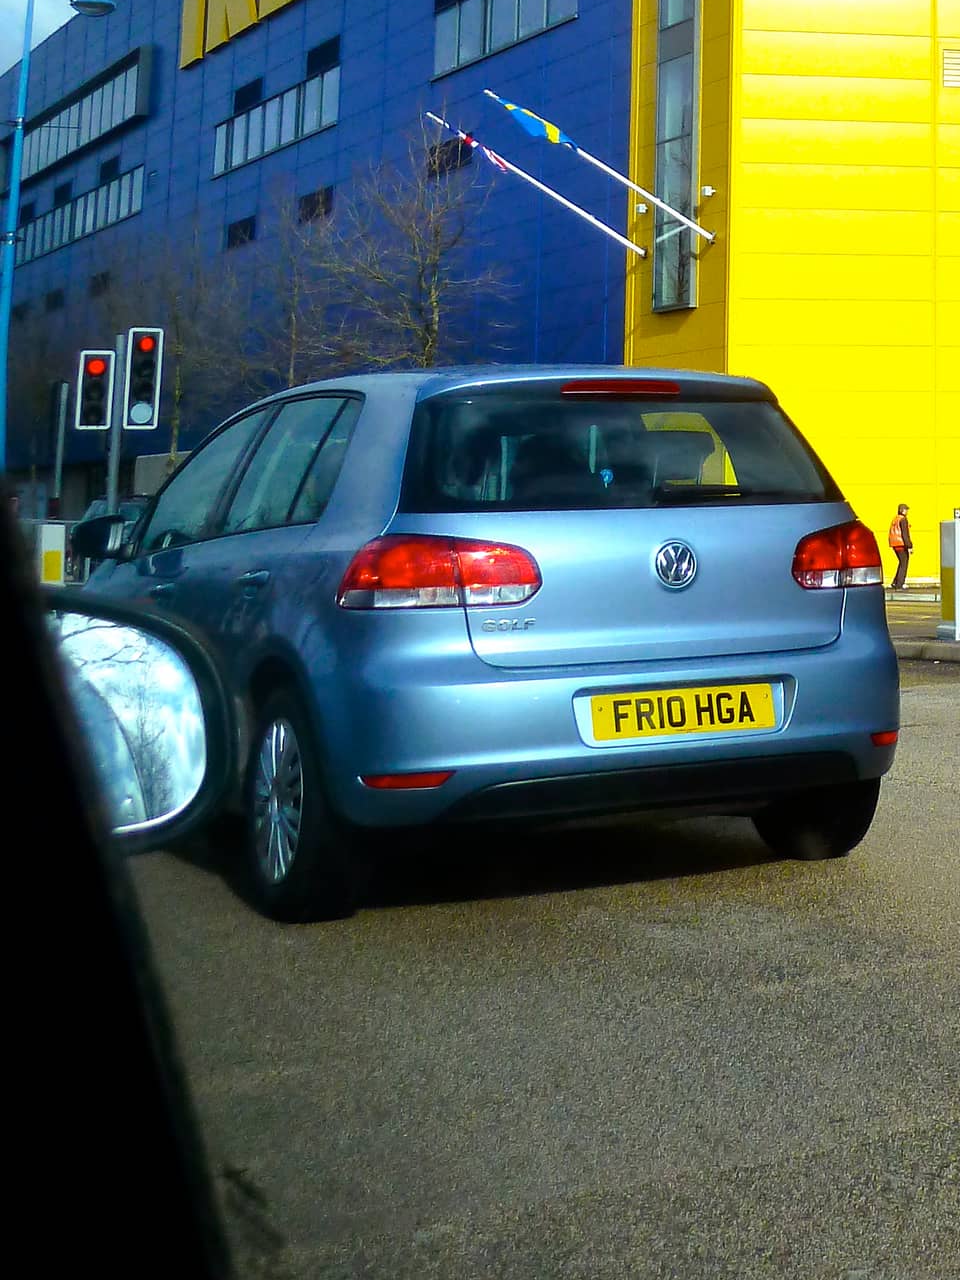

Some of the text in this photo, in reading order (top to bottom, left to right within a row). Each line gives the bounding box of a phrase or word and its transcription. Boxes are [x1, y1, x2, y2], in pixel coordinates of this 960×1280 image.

[481, 617, 536, 632] GOLF
[612, 691, 755, 733] FR10 HGA
